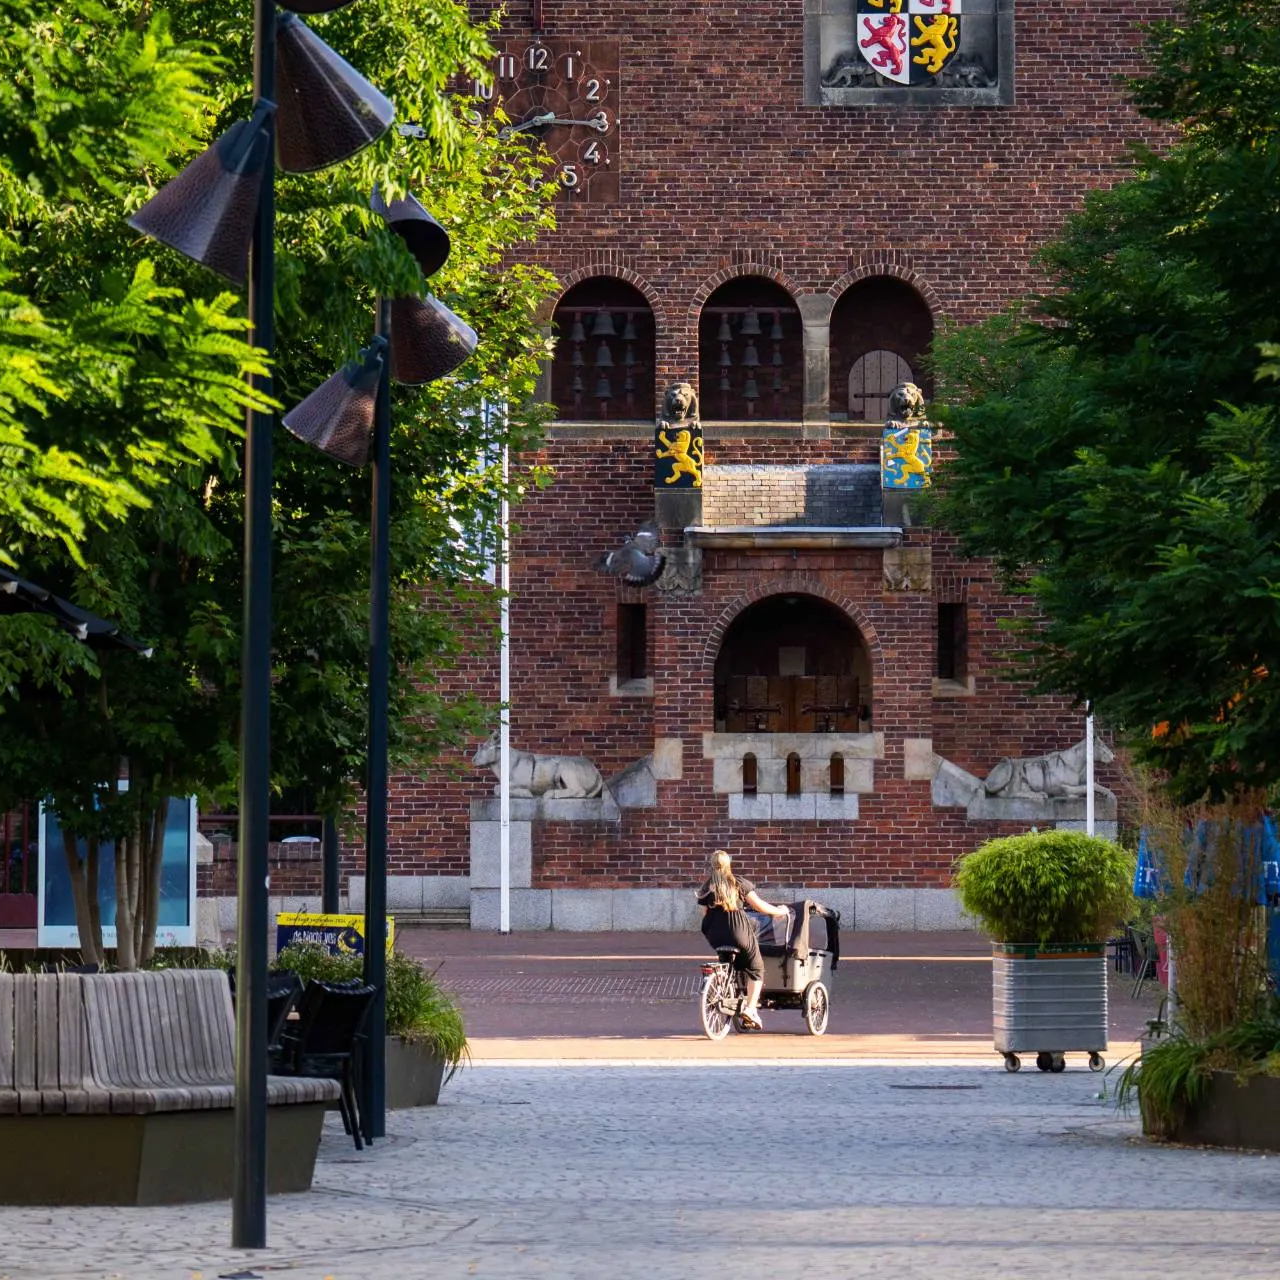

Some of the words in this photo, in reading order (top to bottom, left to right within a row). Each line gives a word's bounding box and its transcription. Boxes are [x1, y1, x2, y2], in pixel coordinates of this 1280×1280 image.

[499, 56, 514, 78] 11
[529, 48, 548, 70] 12
[567, 56, 573, 79] 1
[474, 78, 493, 100] 10
[586, 78, 600, 101] 2
[595, 111, 609, 132] 3
[584, 141, 601, 164] 4
[562, 165, 578, 187] 5
